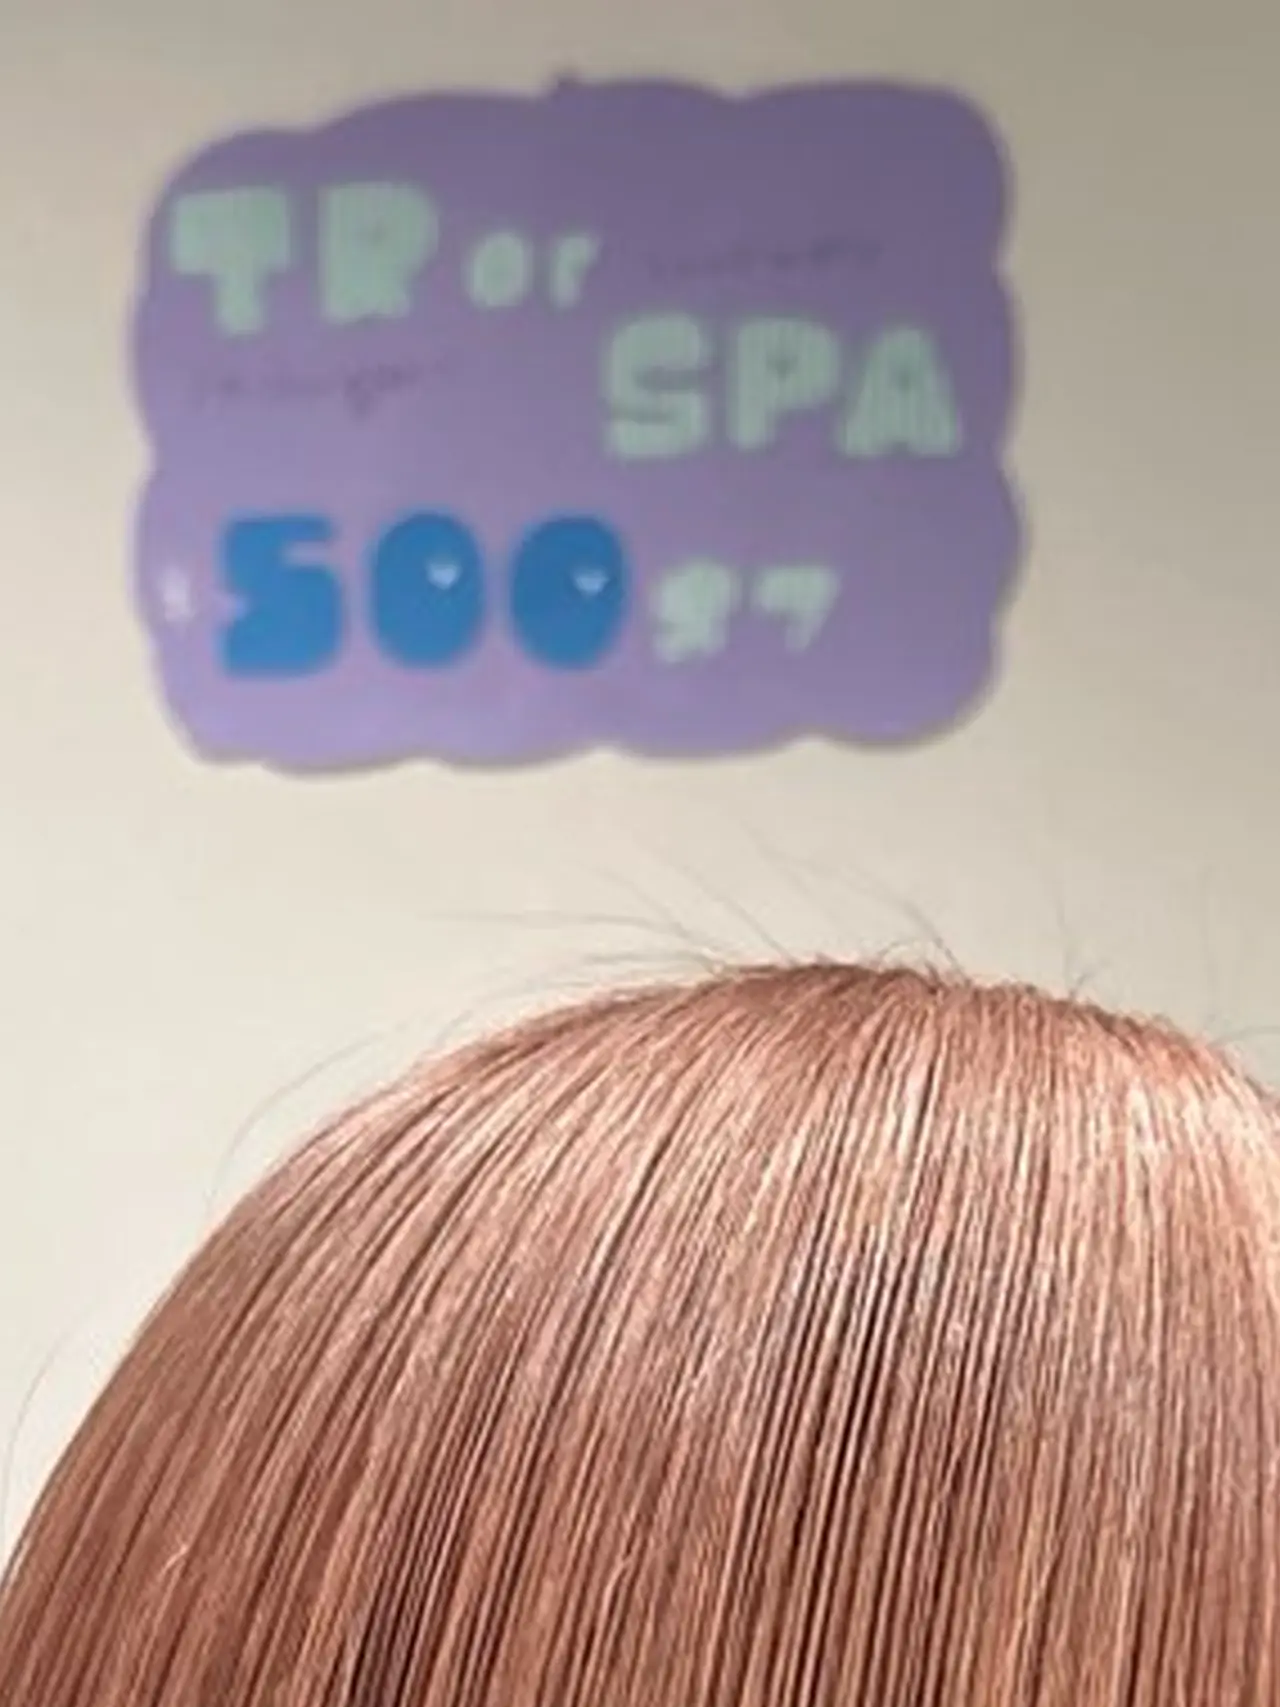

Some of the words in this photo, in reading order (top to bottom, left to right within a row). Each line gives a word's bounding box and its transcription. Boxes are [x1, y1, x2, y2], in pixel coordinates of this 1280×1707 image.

[167, 179, 439, 336] TR
[466, 230, 601, 311] or
[601, 312, 963, 461] SPA
[216, 505, 627, 680] 500
